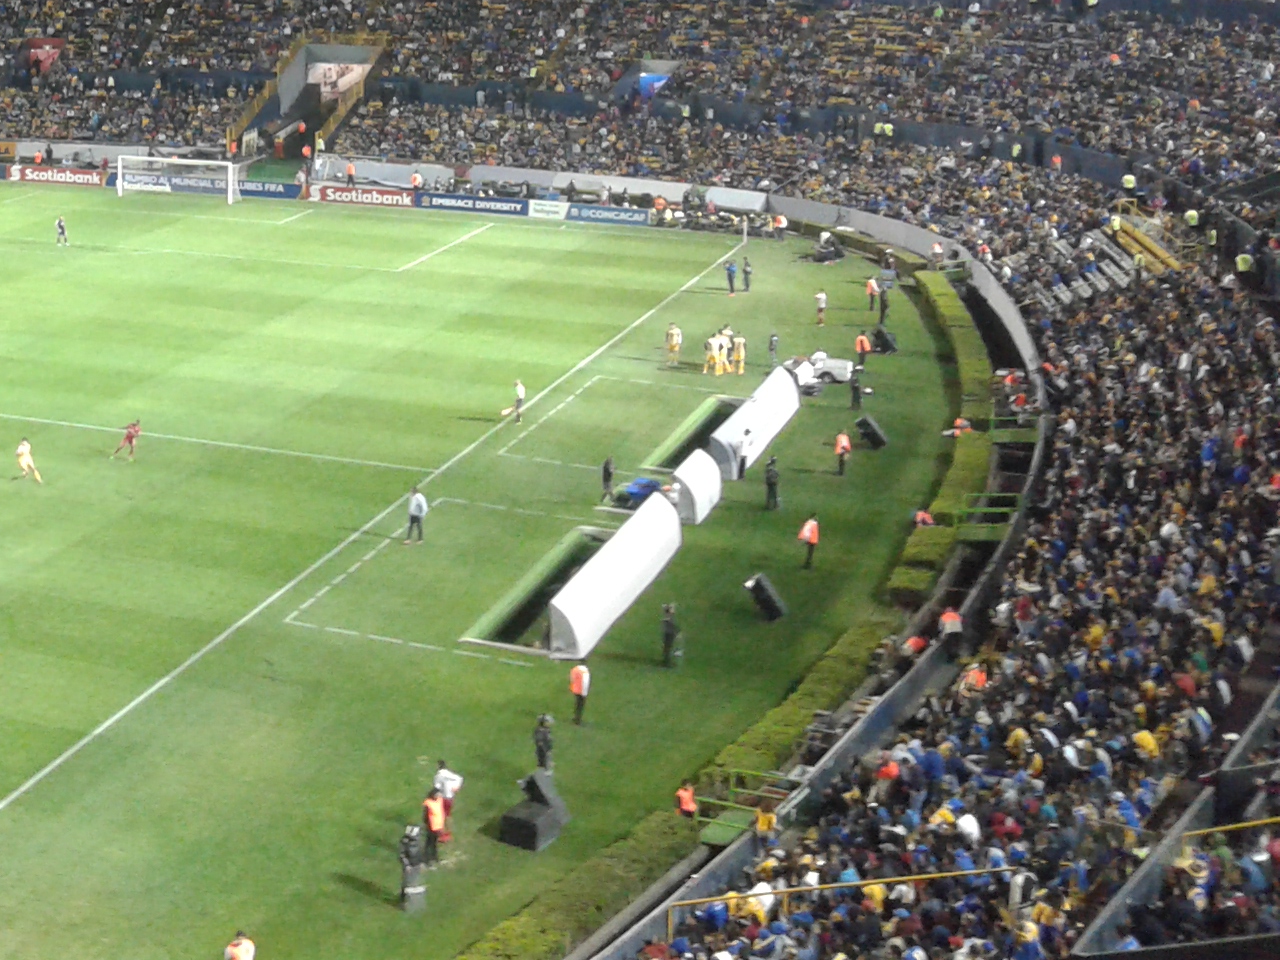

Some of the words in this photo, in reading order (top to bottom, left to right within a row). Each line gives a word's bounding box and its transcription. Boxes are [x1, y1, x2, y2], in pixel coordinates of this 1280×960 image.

[25, 168, 101, 184] Scotiabank
[172, 178, 213, 189] MUNDIAL
[265, 183, 284, 193] FIFA
[326, 189, 412, 206] Scotiabank
[432, 197, 473, 208] EMBRACE
[475, 201, 523, 212] DIVERSITY
